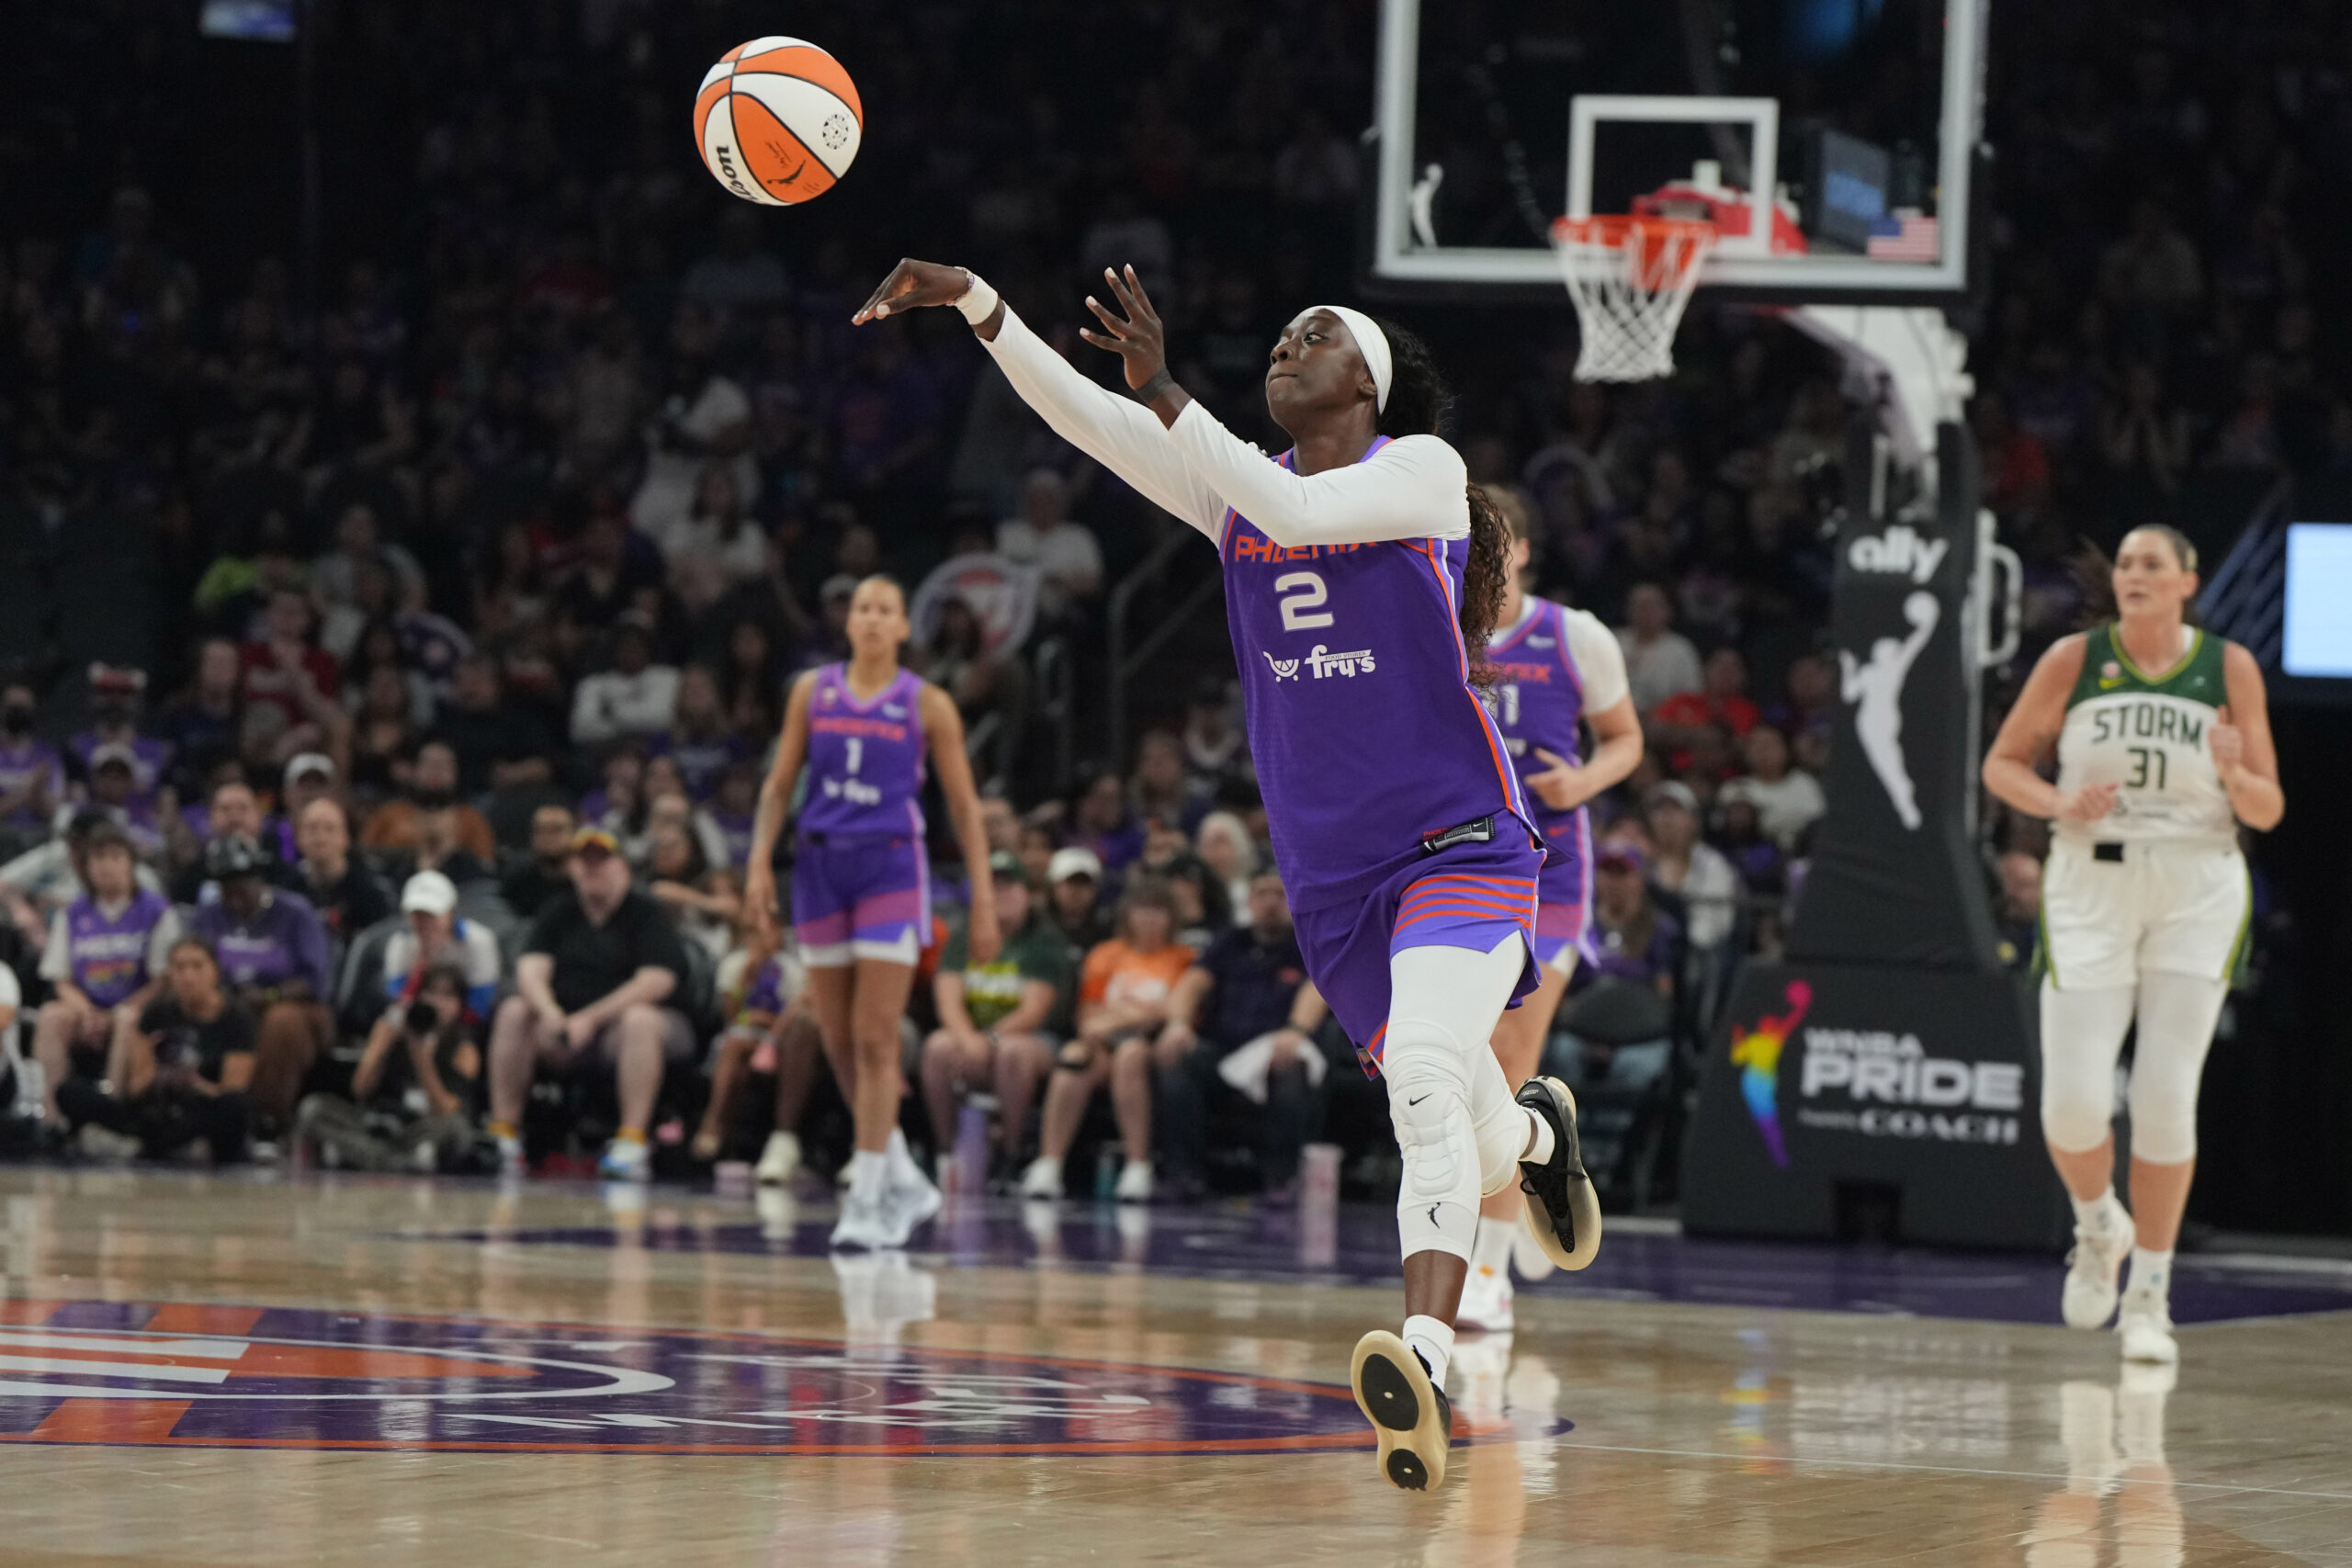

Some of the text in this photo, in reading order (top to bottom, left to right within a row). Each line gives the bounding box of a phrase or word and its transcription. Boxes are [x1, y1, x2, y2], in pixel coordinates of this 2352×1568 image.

[1849, 526, 1949, 584] ally
[1274, 571, 1334, 632] 2
[1305, 644, 1376, 679] fry's
[2093, 704, 2202, 751] STORM
[847, 736, 863, 775] 1
[2126, 746, 2166, 790] 31
[1804, 1027, 1924, 1057] WNBA
[1801, 1053, 2022, 1110] PRIDE
[1858, 1109, 2019, 1145] COACH
